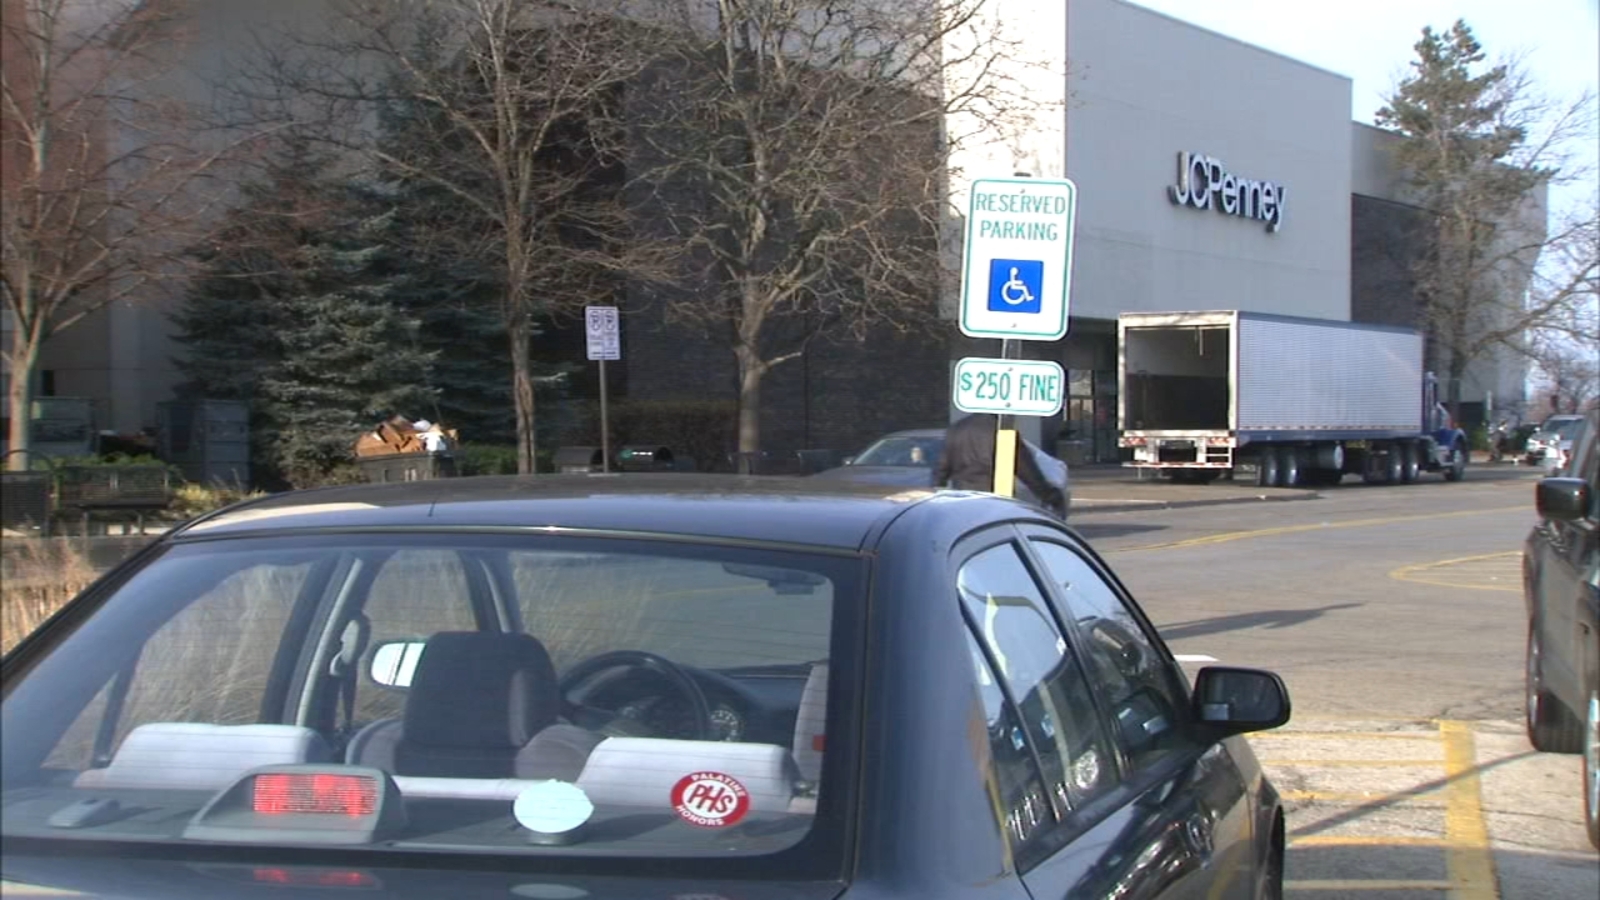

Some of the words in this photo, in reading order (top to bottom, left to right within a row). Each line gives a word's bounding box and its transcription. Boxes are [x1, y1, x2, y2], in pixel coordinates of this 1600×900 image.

[1167, 151, 1287, 232] JCPenney
[975, 193, 1066, 215] RESERVED
[980, 220, 1058, 241] PARKING
[1019, 374, 1057, 402] FINE
[690, 773, 747, 797] PALATINE
[687, 784, 734, 813] PHS
[675, 805, 725, 826] HONORS
